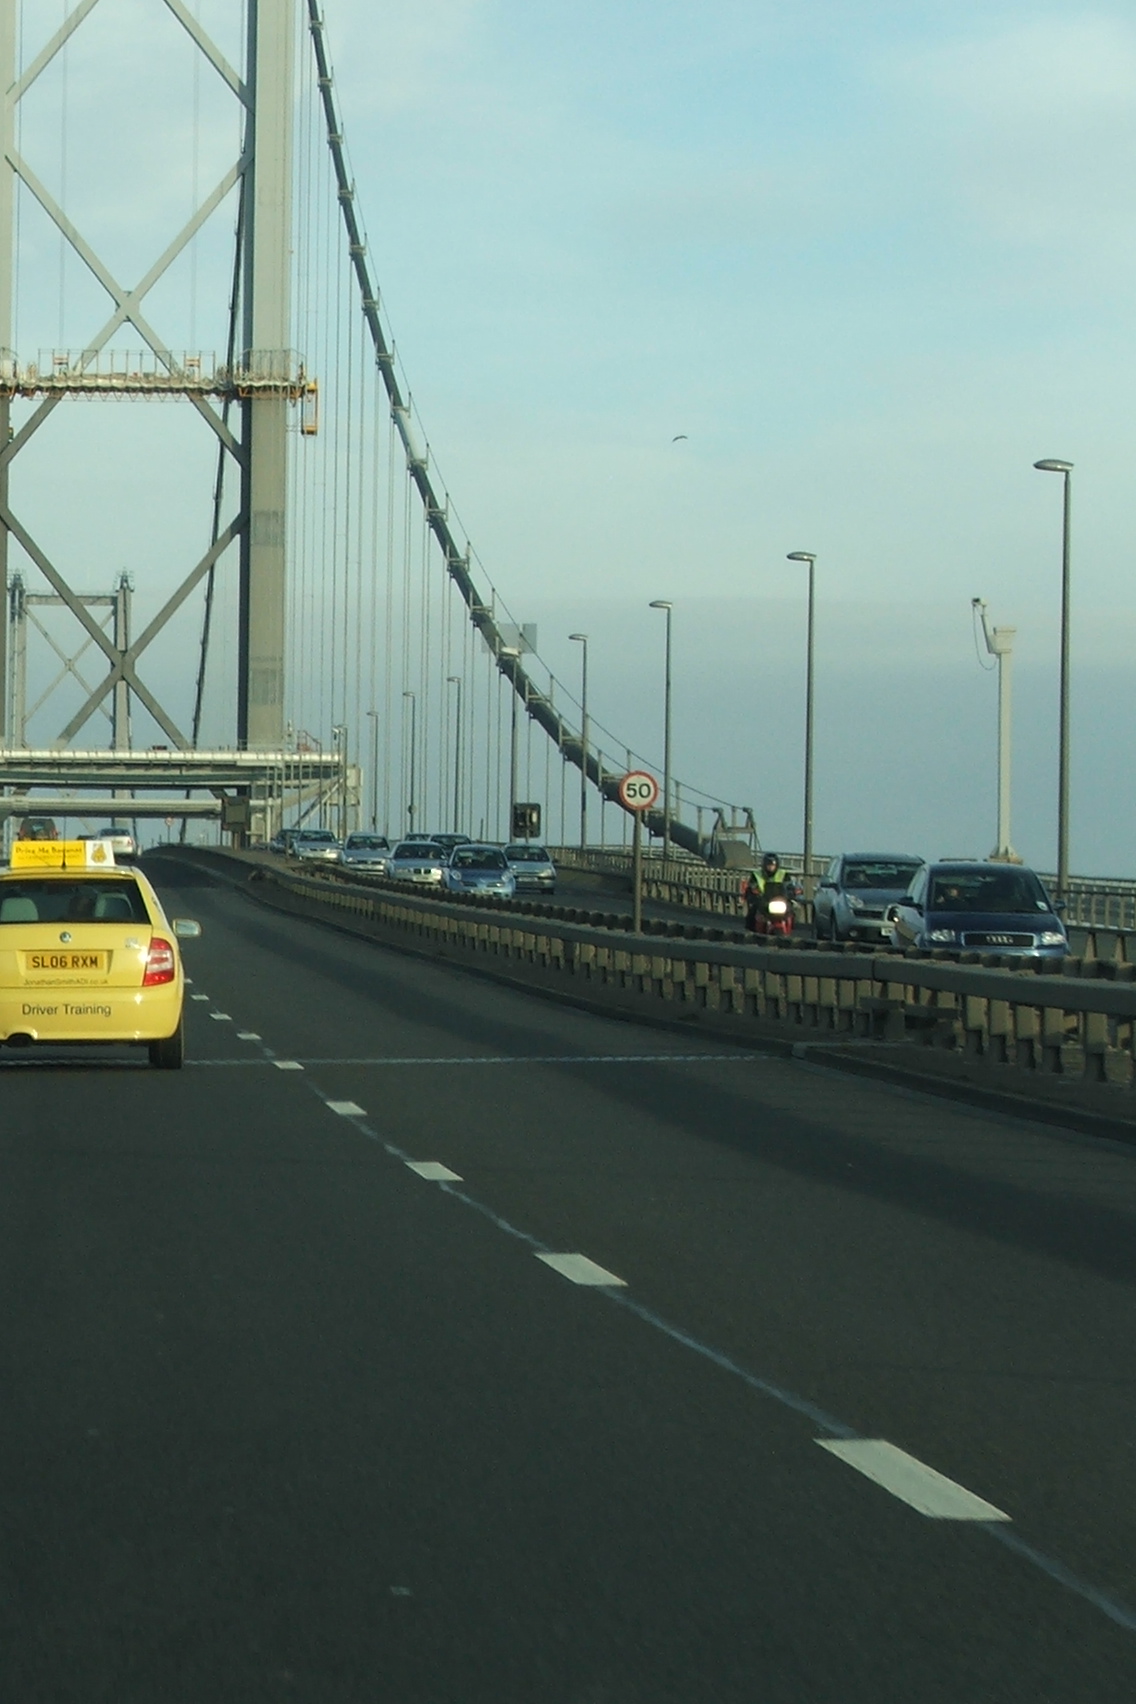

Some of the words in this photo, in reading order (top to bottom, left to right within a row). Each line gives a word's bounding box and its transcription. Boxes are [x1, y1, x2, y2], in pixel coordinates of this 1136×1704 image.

[626, 783, 651, 798] 50
[15, 846, 35, 854] Drive
[32, 955, 68, 968] SL06
[71, 955, 98, 968] RXM
[22, 1003, 58, 1015] Driver
[63, 1003, 112, 1017] Training
